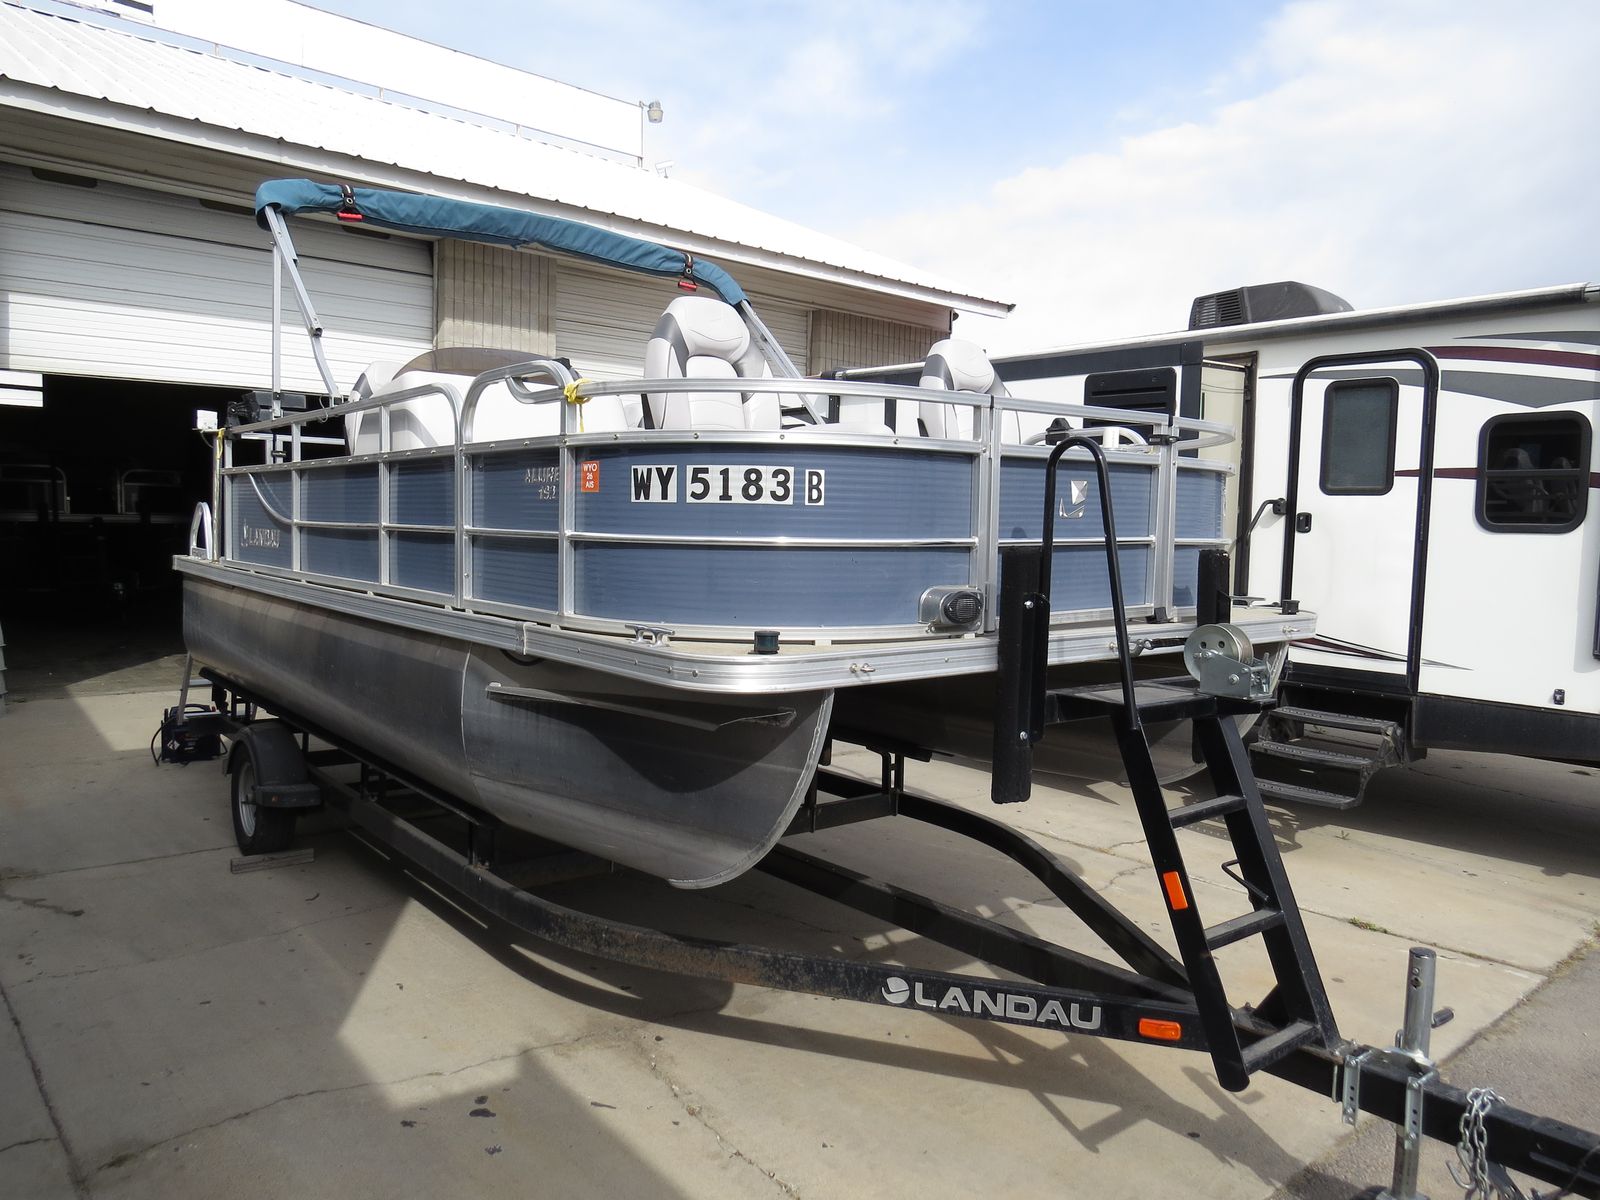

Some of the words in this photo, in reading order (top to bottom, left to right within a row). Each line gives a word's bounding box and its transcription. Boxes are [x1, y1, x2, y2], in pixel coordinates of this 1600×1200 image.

[583, 463, 598, 472] WYO
[633, 467, 675, 500] WY
[690, 467, 791, 502] 5183
[807, 470, 823, 504] B
[914, 982, 1101, 1030] LANDAU
